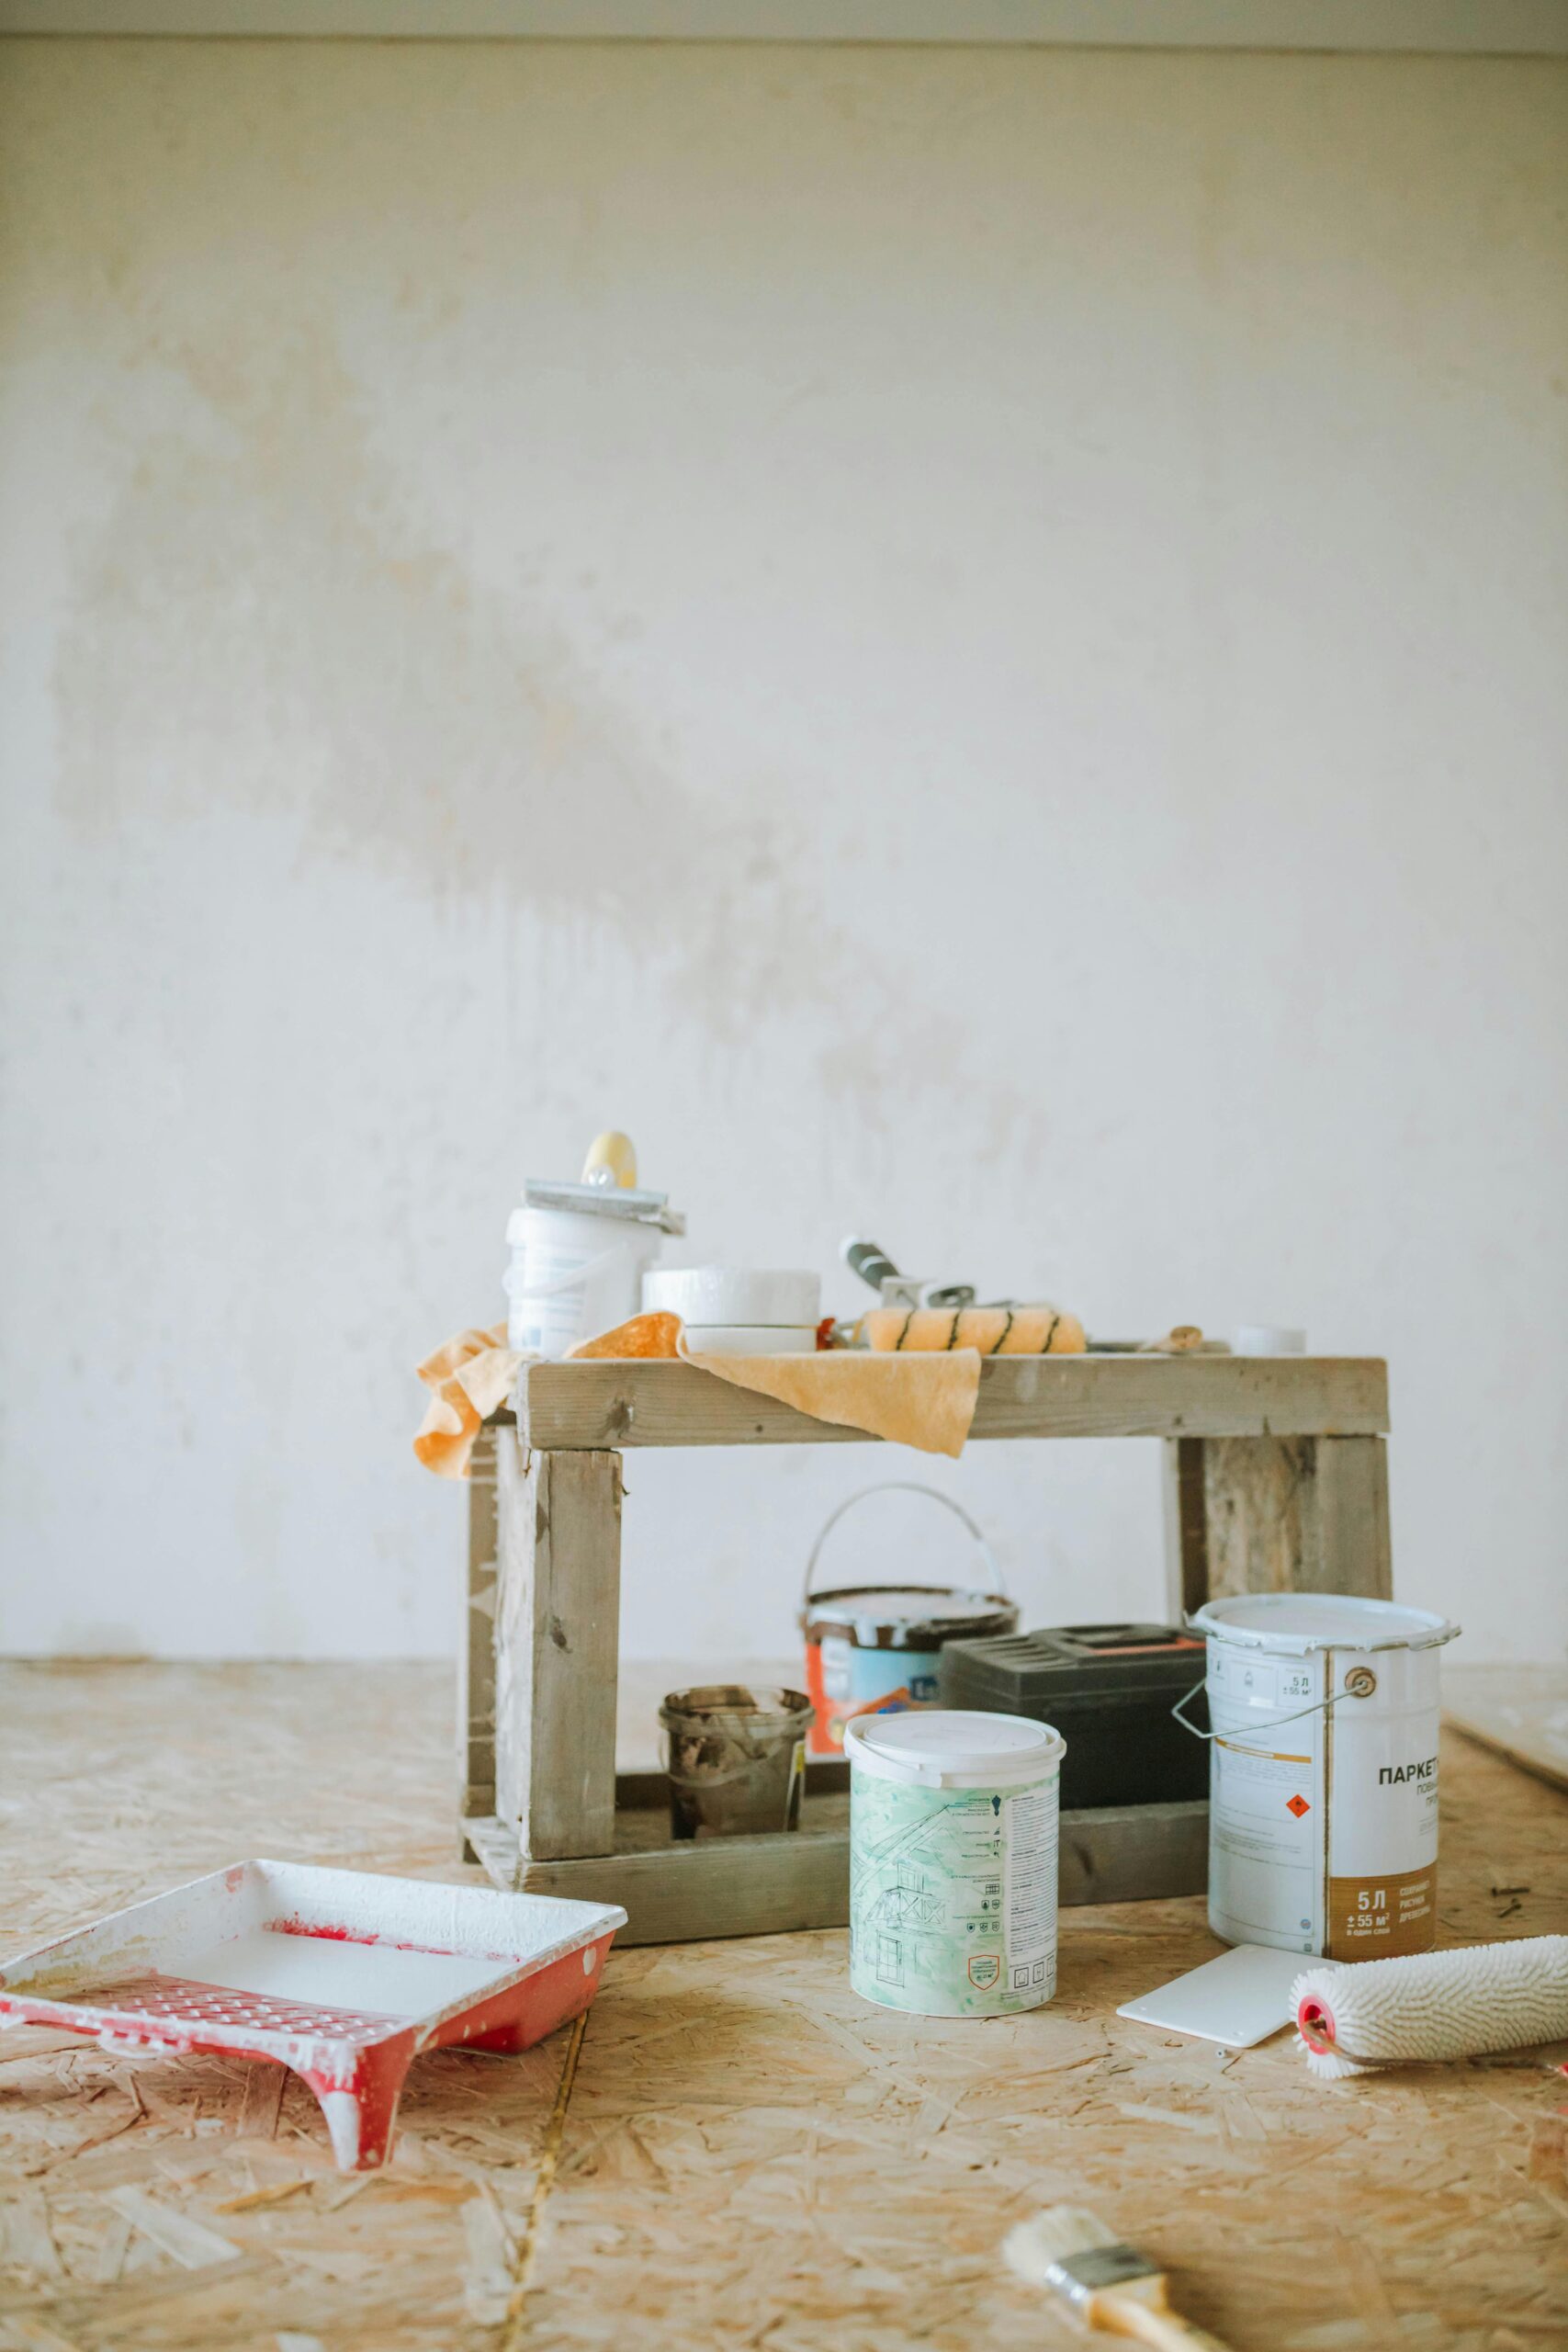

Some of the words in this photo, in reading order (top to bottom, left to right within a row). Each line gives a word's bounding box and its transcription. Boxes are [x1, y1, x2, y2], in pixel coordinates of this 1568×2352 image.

[1292, 1677, 1300, 1687] 5
[1358, 1891, 1371, 1911] 5
[1372, 1890, 1386, 1910] Л
[1358, 1914, 1373, 1928] 55
